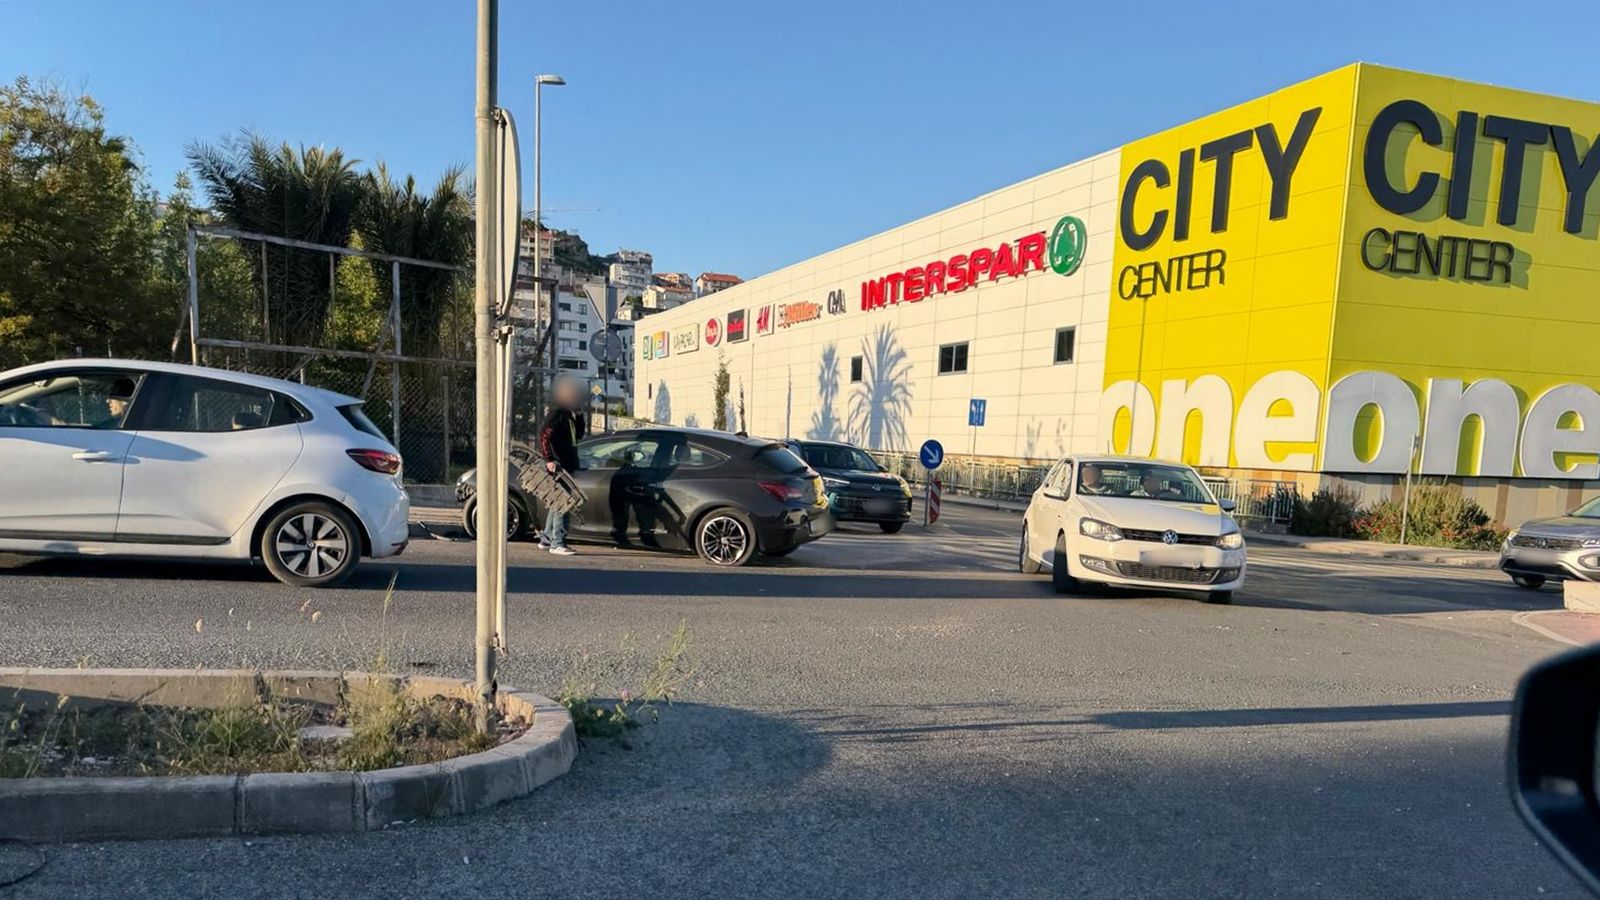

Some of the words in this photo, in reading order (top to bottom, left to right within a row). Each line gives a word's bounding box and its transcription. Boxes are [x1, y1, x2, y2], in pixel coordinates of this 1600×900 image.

[1119, 106, 1323, 252] CITY
[1363, 99, 1600, 235] CITY
[861, 231, 1046, 311] INTERSPAR
[1118, 248, 1227, 300] CENTER
[1360, 227, 1515, 284] CENTER
[1100, 370, 1322, 472] one
[1322, 370, 1600, 479] one
